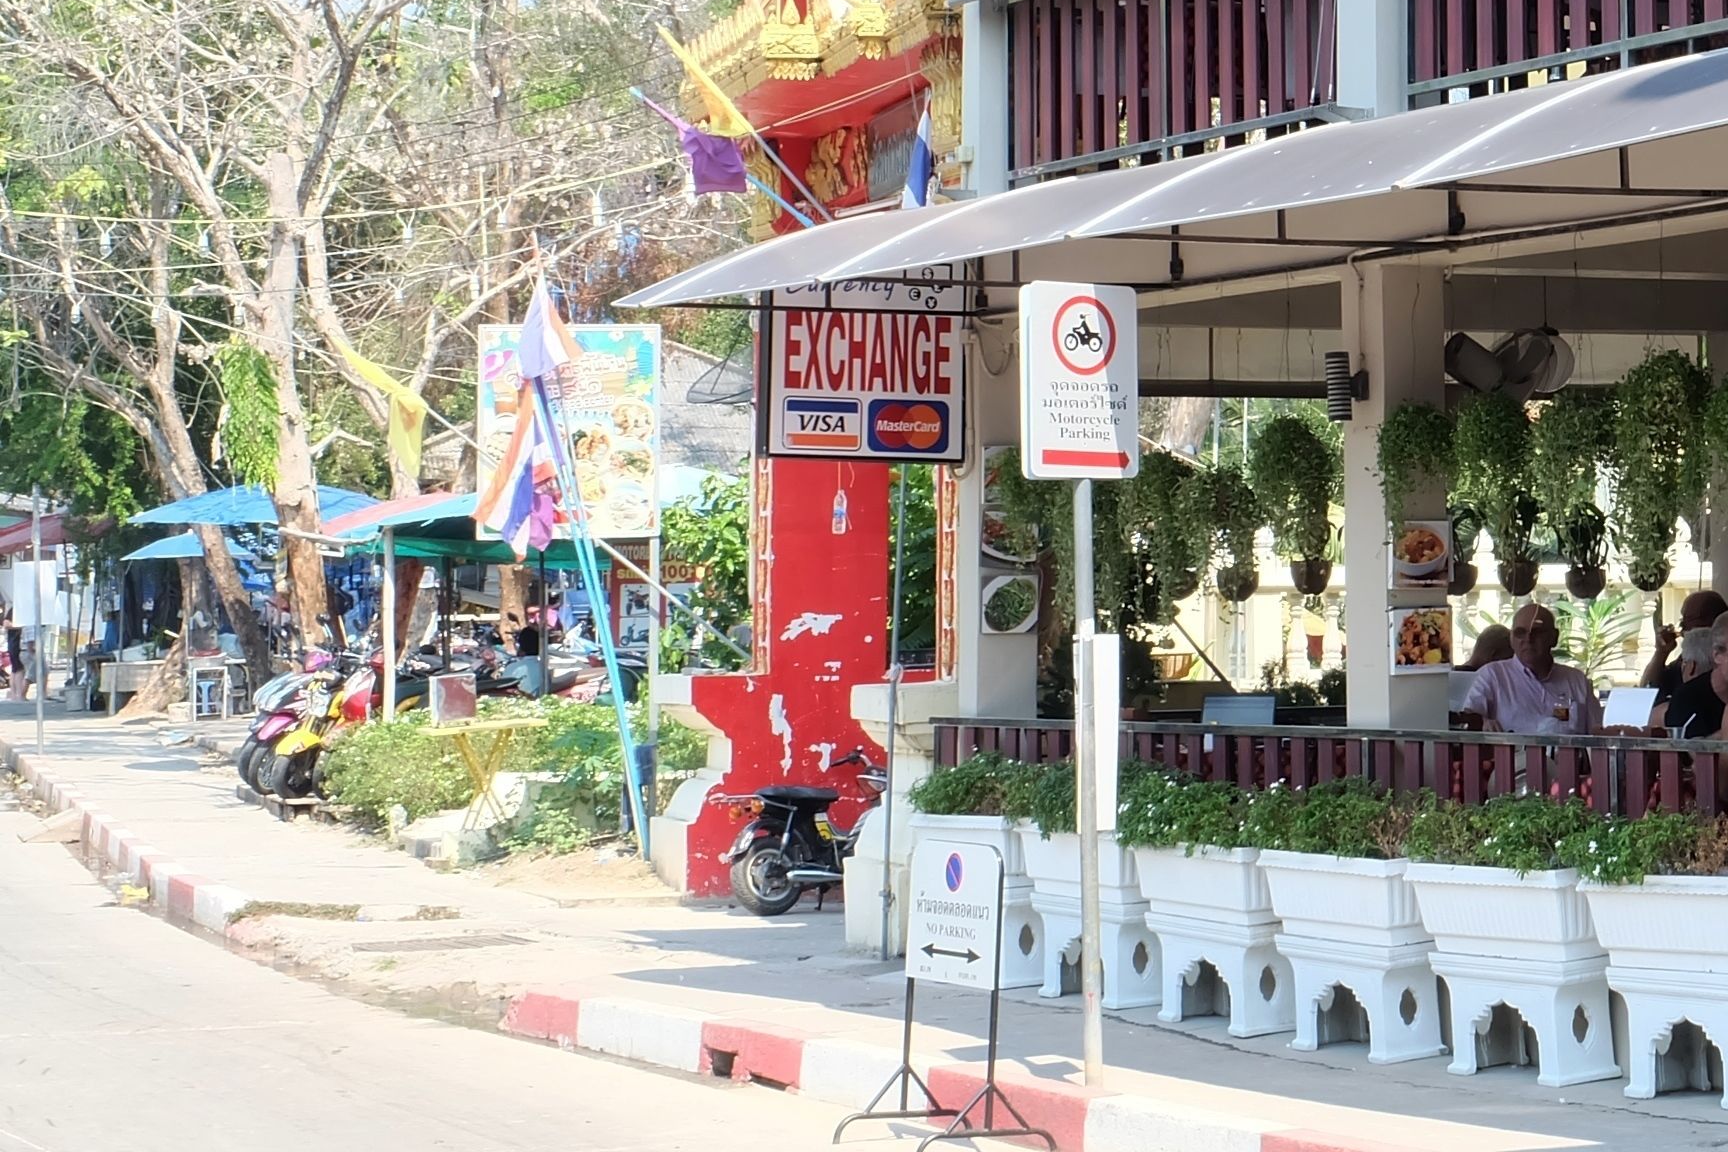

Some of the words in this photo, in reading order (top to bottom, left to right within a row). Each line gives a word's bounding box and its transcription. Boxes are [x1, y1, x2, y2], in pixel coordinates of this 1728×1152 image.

[784, 310, 952, 395] EXCHANGE
[798, 414, 846, 433] VISA
[876, 419, 941, 433] MasterCard
[1049, 412, 1120, 428] Motorcycle
[1060, 427, 1111, 441] Parking
[926, 922, 938, 935] NO
[939, 924, 976, 940] PARKING
